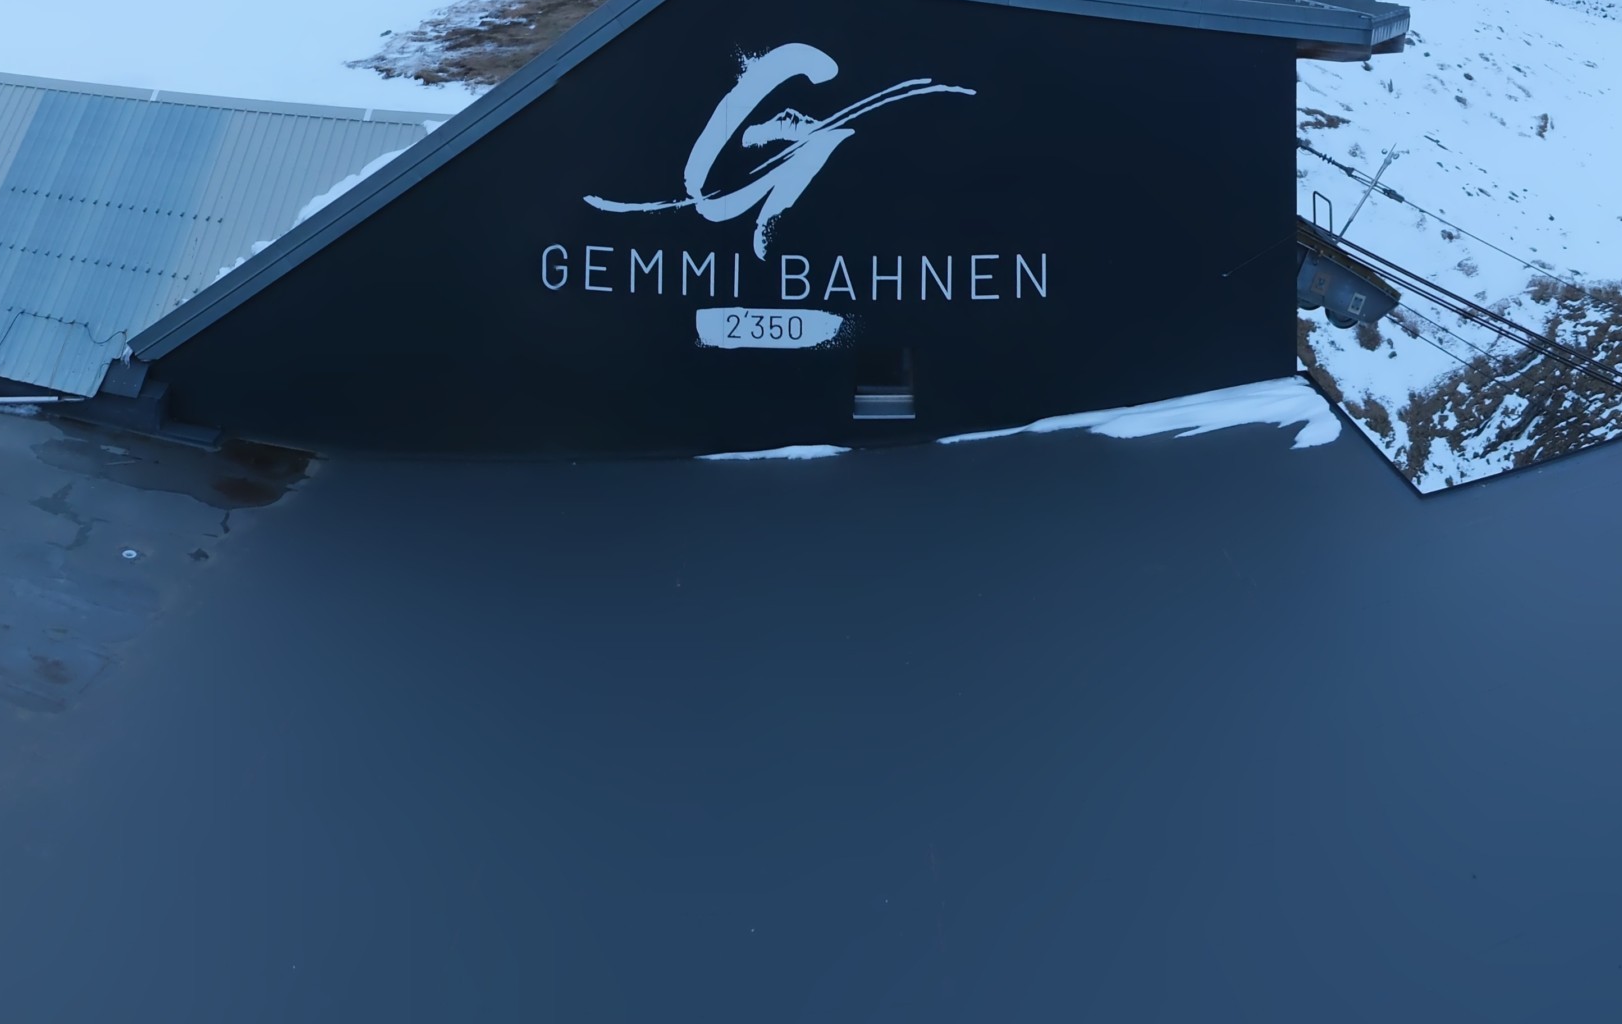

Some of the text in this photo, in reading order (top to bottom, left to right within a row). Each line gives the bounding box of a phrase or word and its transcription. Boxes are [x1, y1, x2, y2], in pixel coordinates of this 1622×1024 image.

[541, 244, 1047, 301] GEMMI BAHNEN
[726, 310, 804, 341] 2'350
